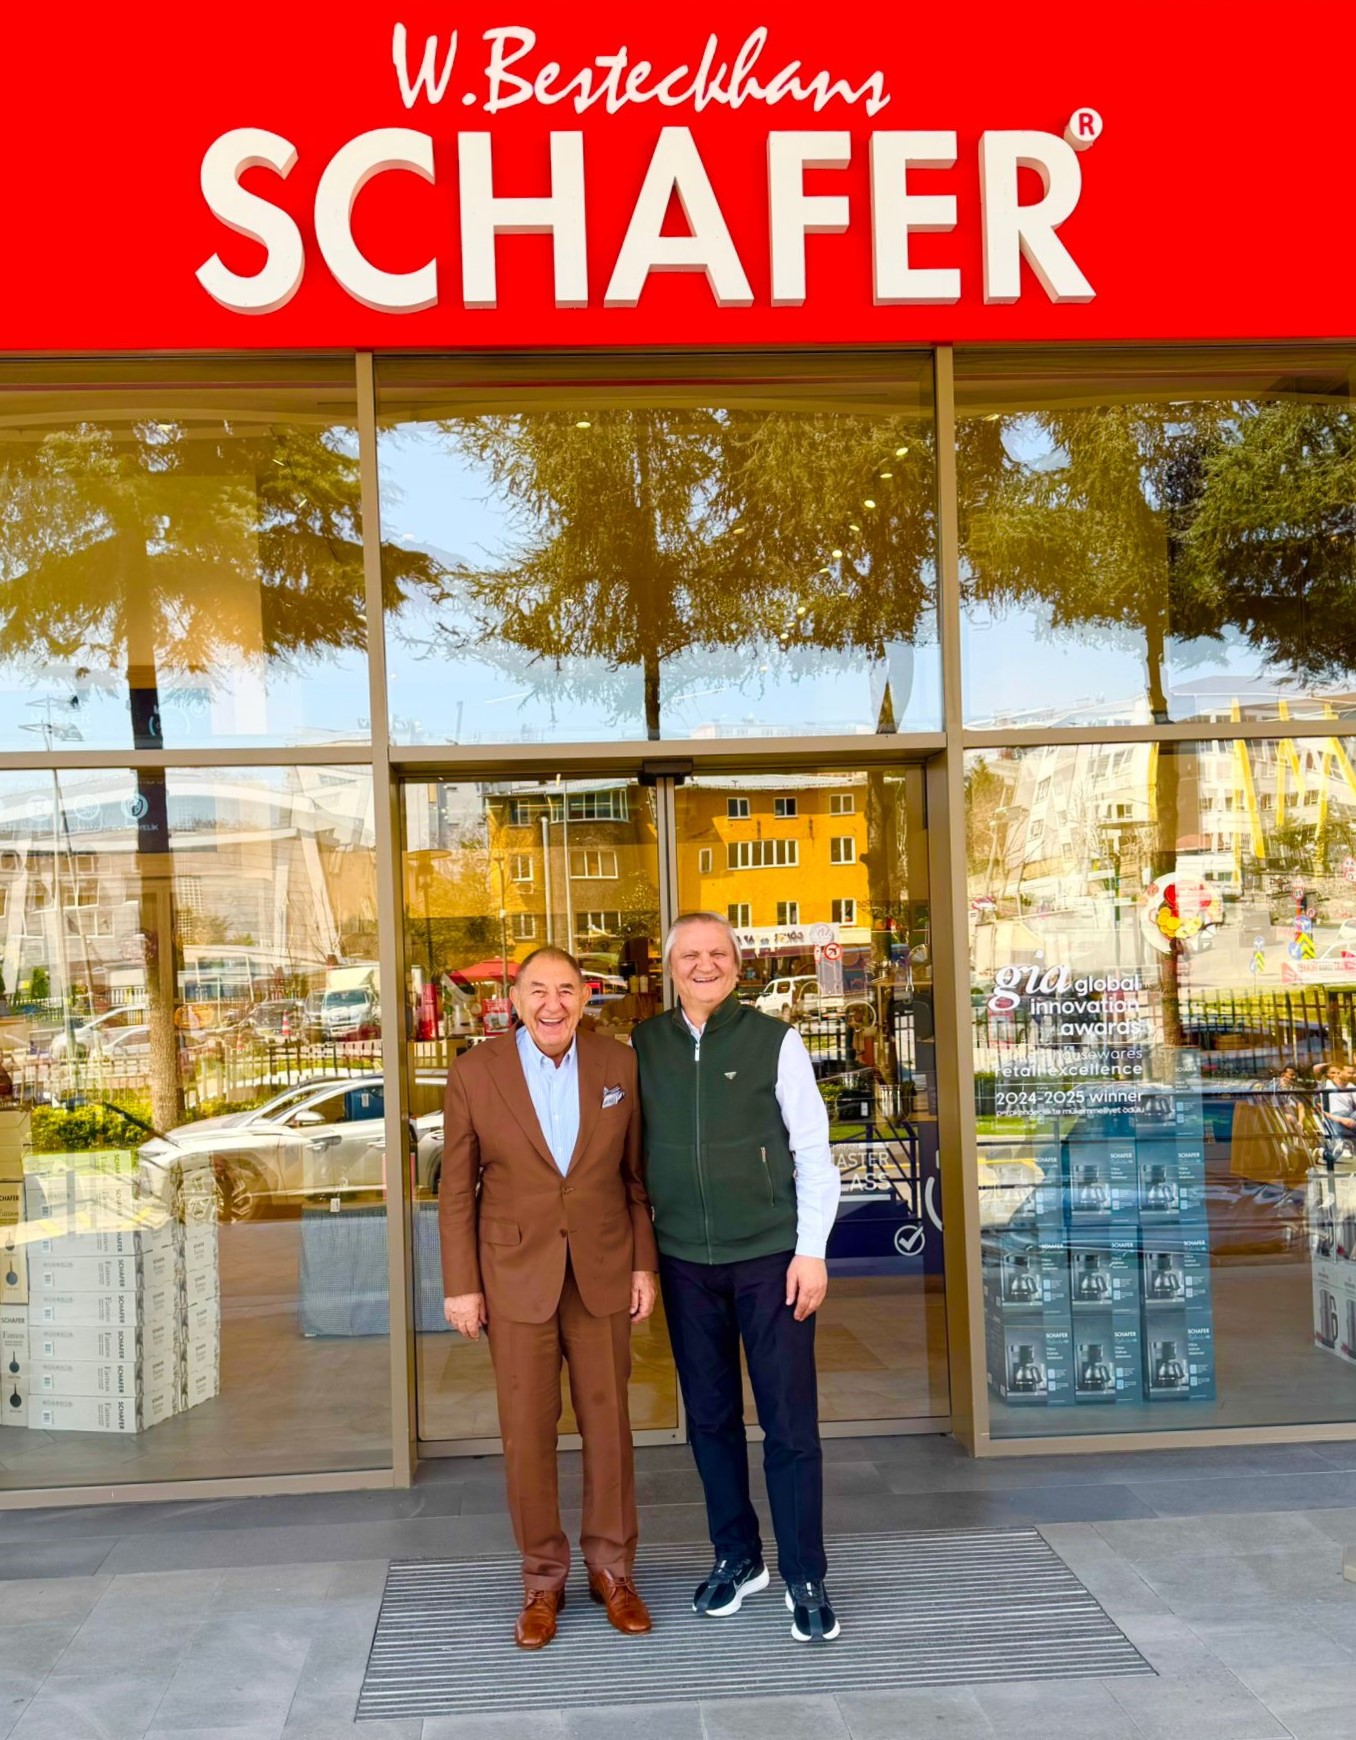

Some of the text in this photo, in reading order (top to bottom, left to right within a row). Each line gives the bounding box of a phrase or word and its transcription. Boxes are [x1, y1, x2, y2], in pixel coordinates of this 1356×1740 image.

[196, 127, 1096, 312] SCHAFER
[988, 950, 1072, 1012] gia
[1074, 975, 1139, 997] global
[1030, 997, 1139, 1015] innovation
[1060, 1020, 1142, 1036] awards
[995, 1063, 1143, 1078] retail excellence
[996, 1089, 1144, 1106] 2024-2025 winner
[840, 1173, 892, 1191] ASS
